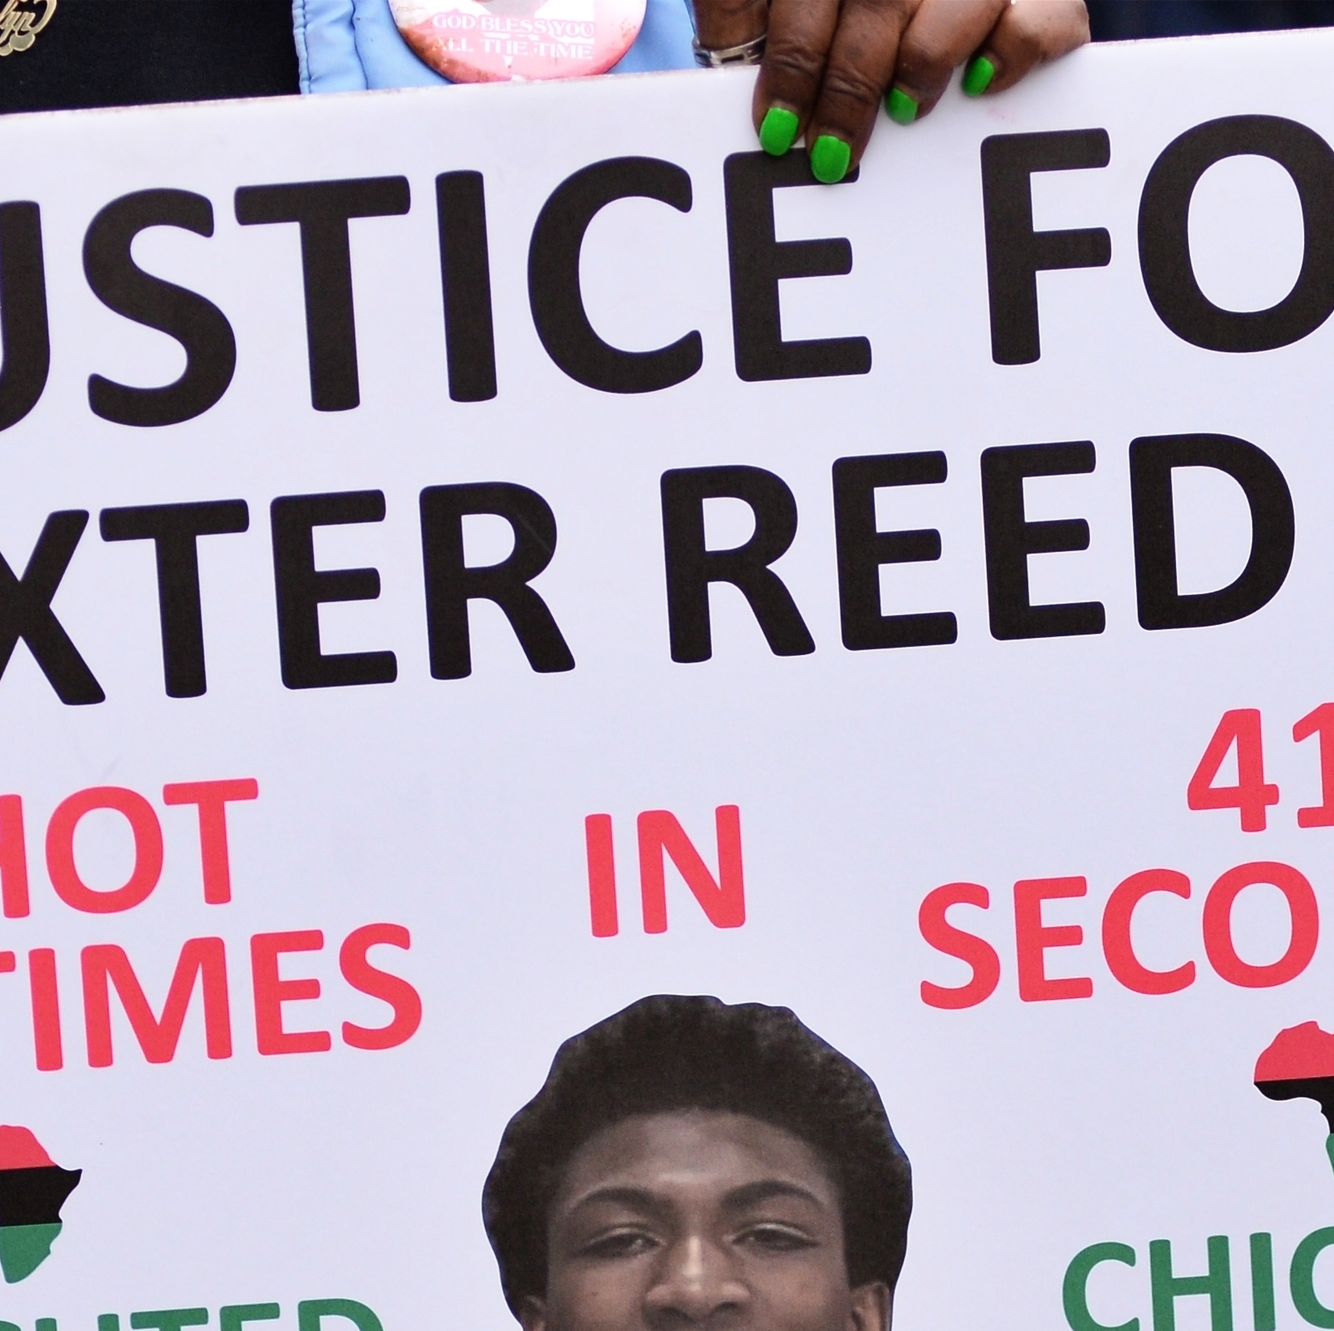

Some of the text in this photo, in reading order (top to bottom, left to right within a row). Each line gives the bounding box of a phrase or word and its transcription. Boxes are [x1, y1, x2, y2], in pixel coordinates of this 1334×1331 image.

[432, 13, 595, 38] GOD BLESS YOU
[432, 37, 594, 60] ALL THE TIME
[660, 433, 1295, 663] REED
[585, 805, 745, 938] IN
